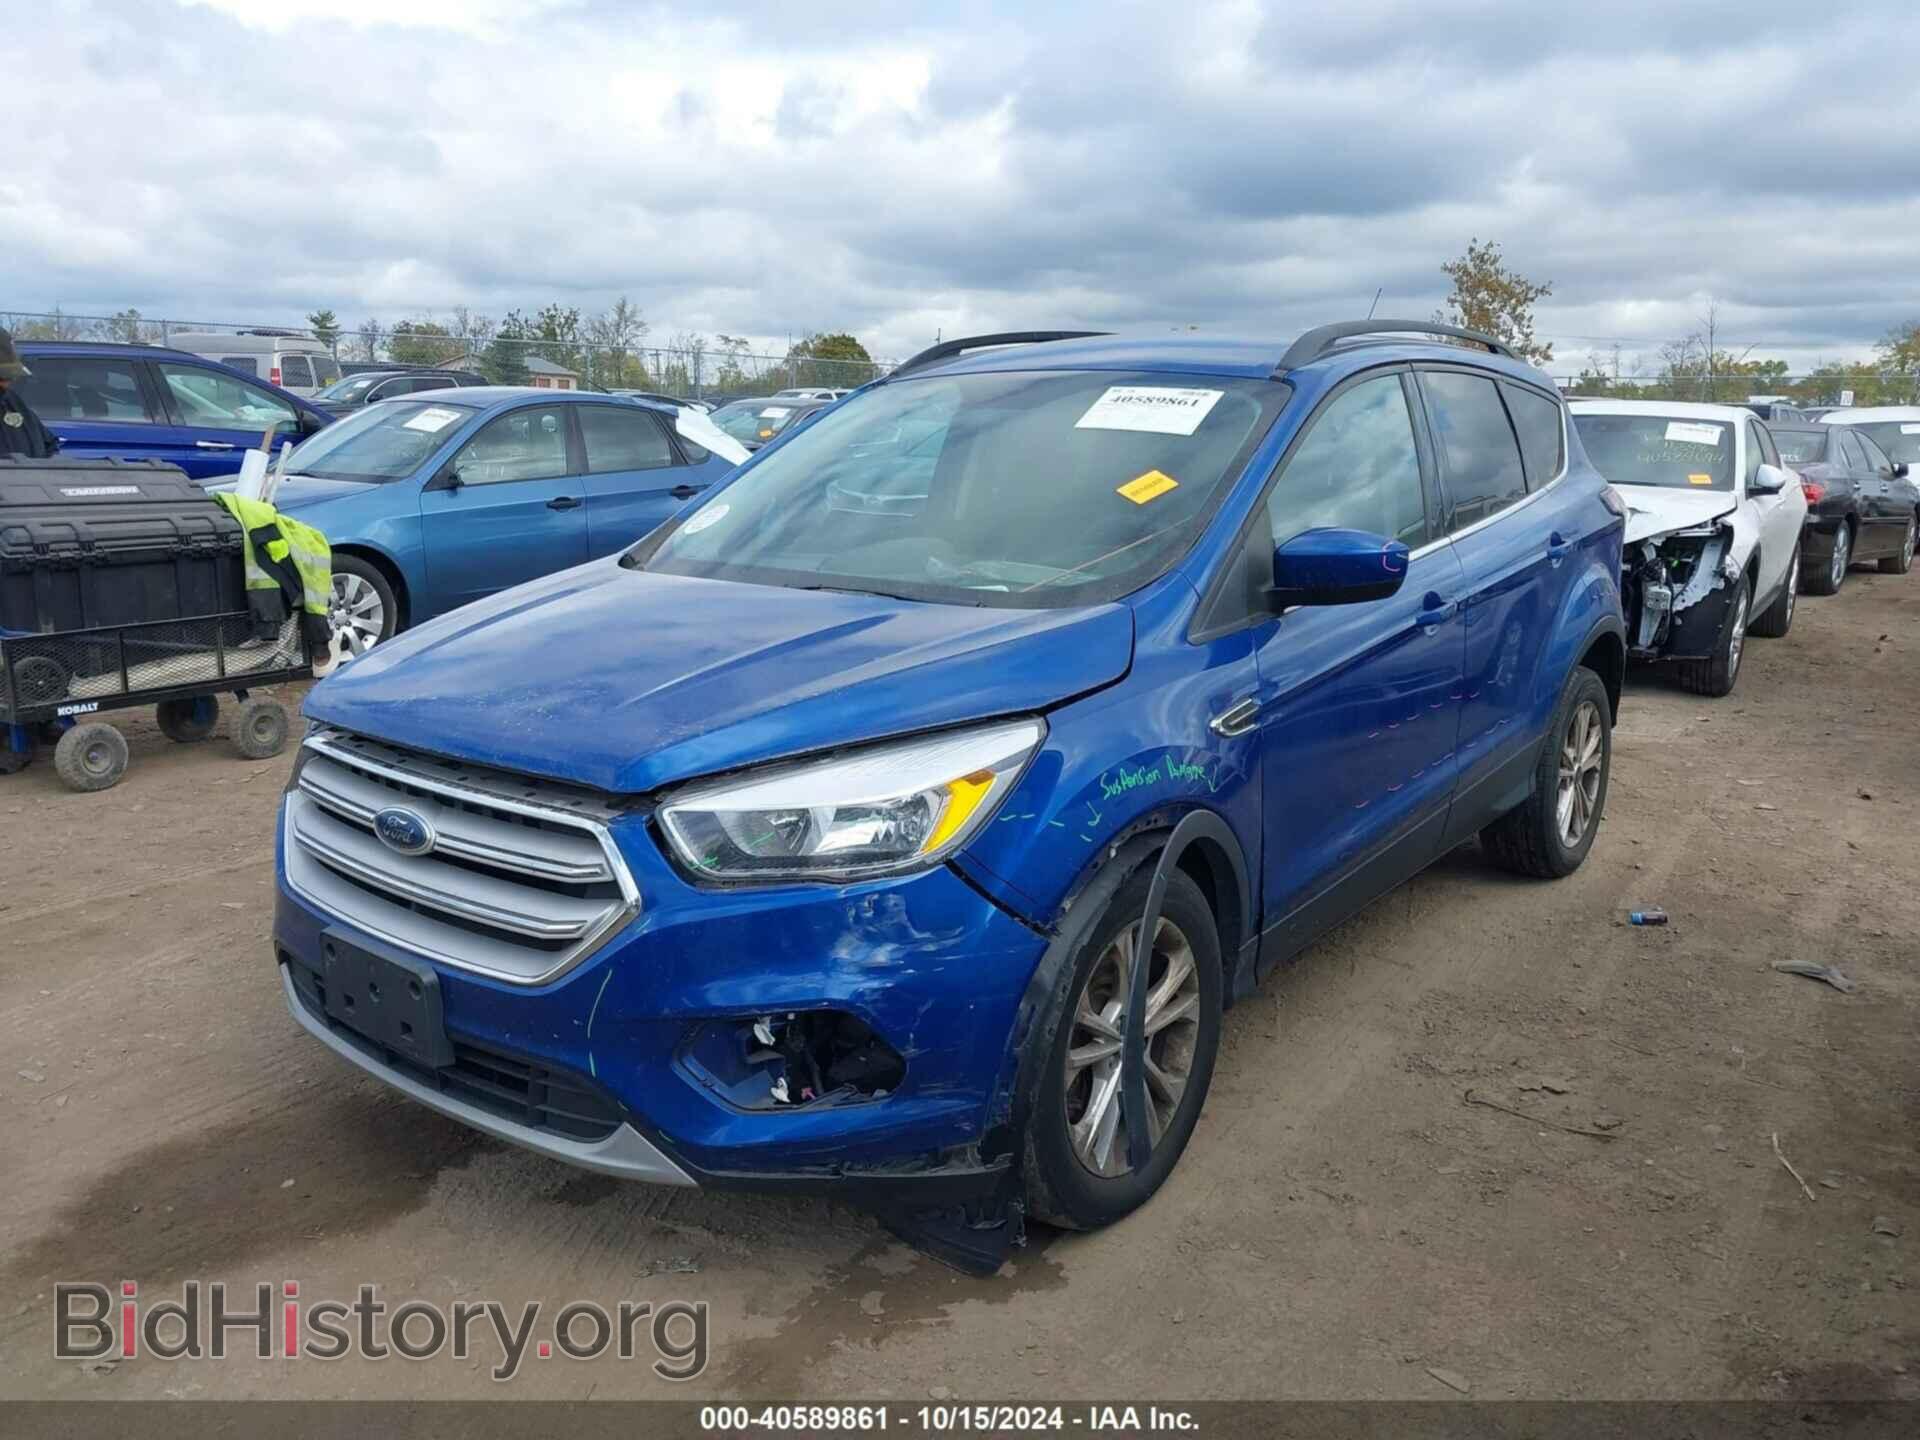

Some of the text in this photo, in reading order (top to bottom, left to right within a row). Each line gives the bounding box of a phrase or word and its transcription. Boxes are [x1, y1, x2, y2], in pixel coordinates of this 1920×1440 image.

[1110, 395, 1199, 407] 40589861
[57, 701, 99, 717] KOBALT
[383, 814, 415, 844] Ford
